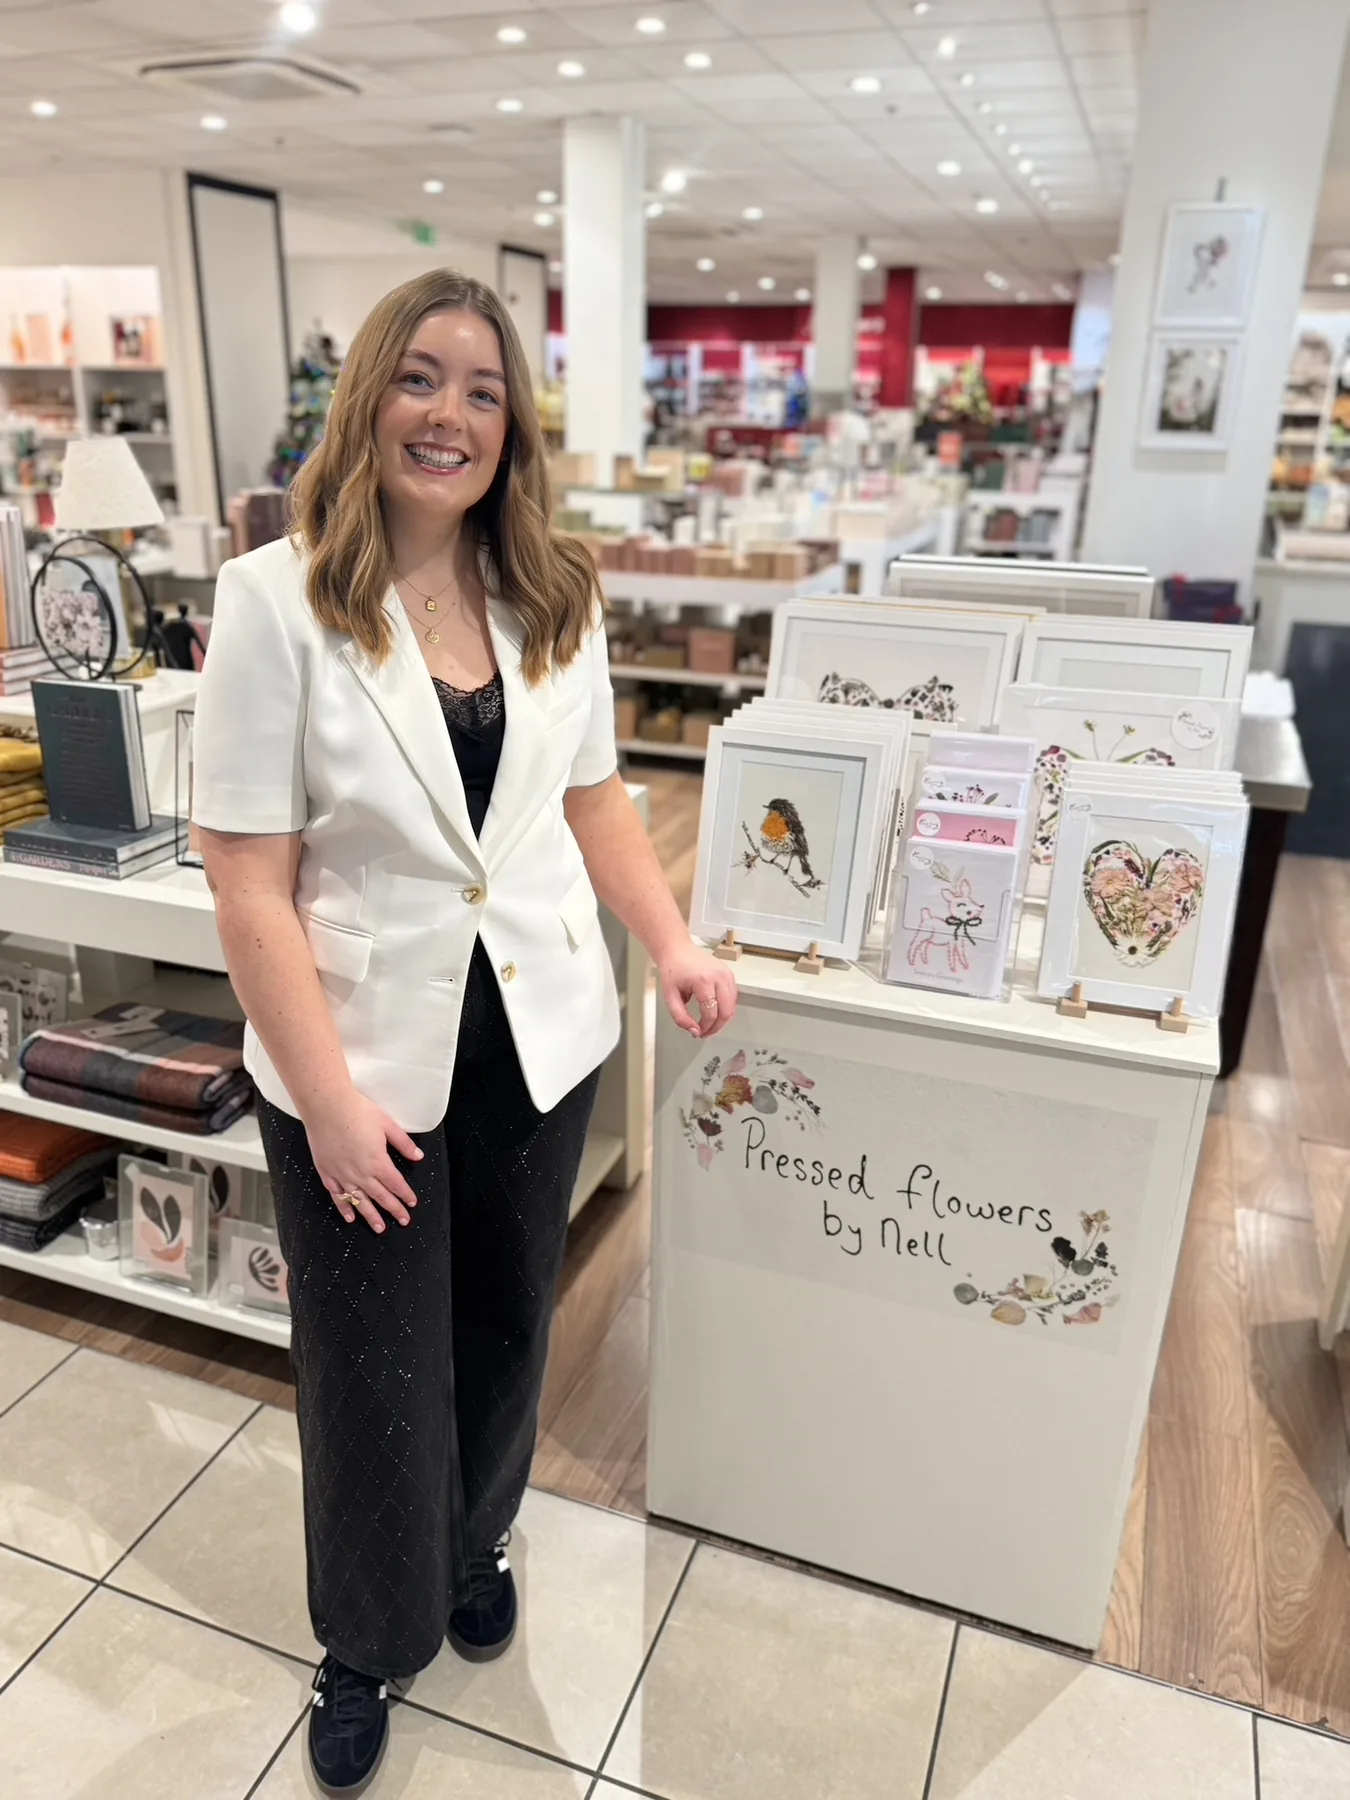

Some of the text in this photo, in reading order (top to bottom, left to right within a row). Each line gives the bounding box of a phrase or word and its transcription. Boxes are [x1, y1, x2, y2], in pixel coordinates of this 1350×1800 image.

[740, 1116, 1053, 1233] Pressed flowers
[823, 1199, 863, 1257] by
